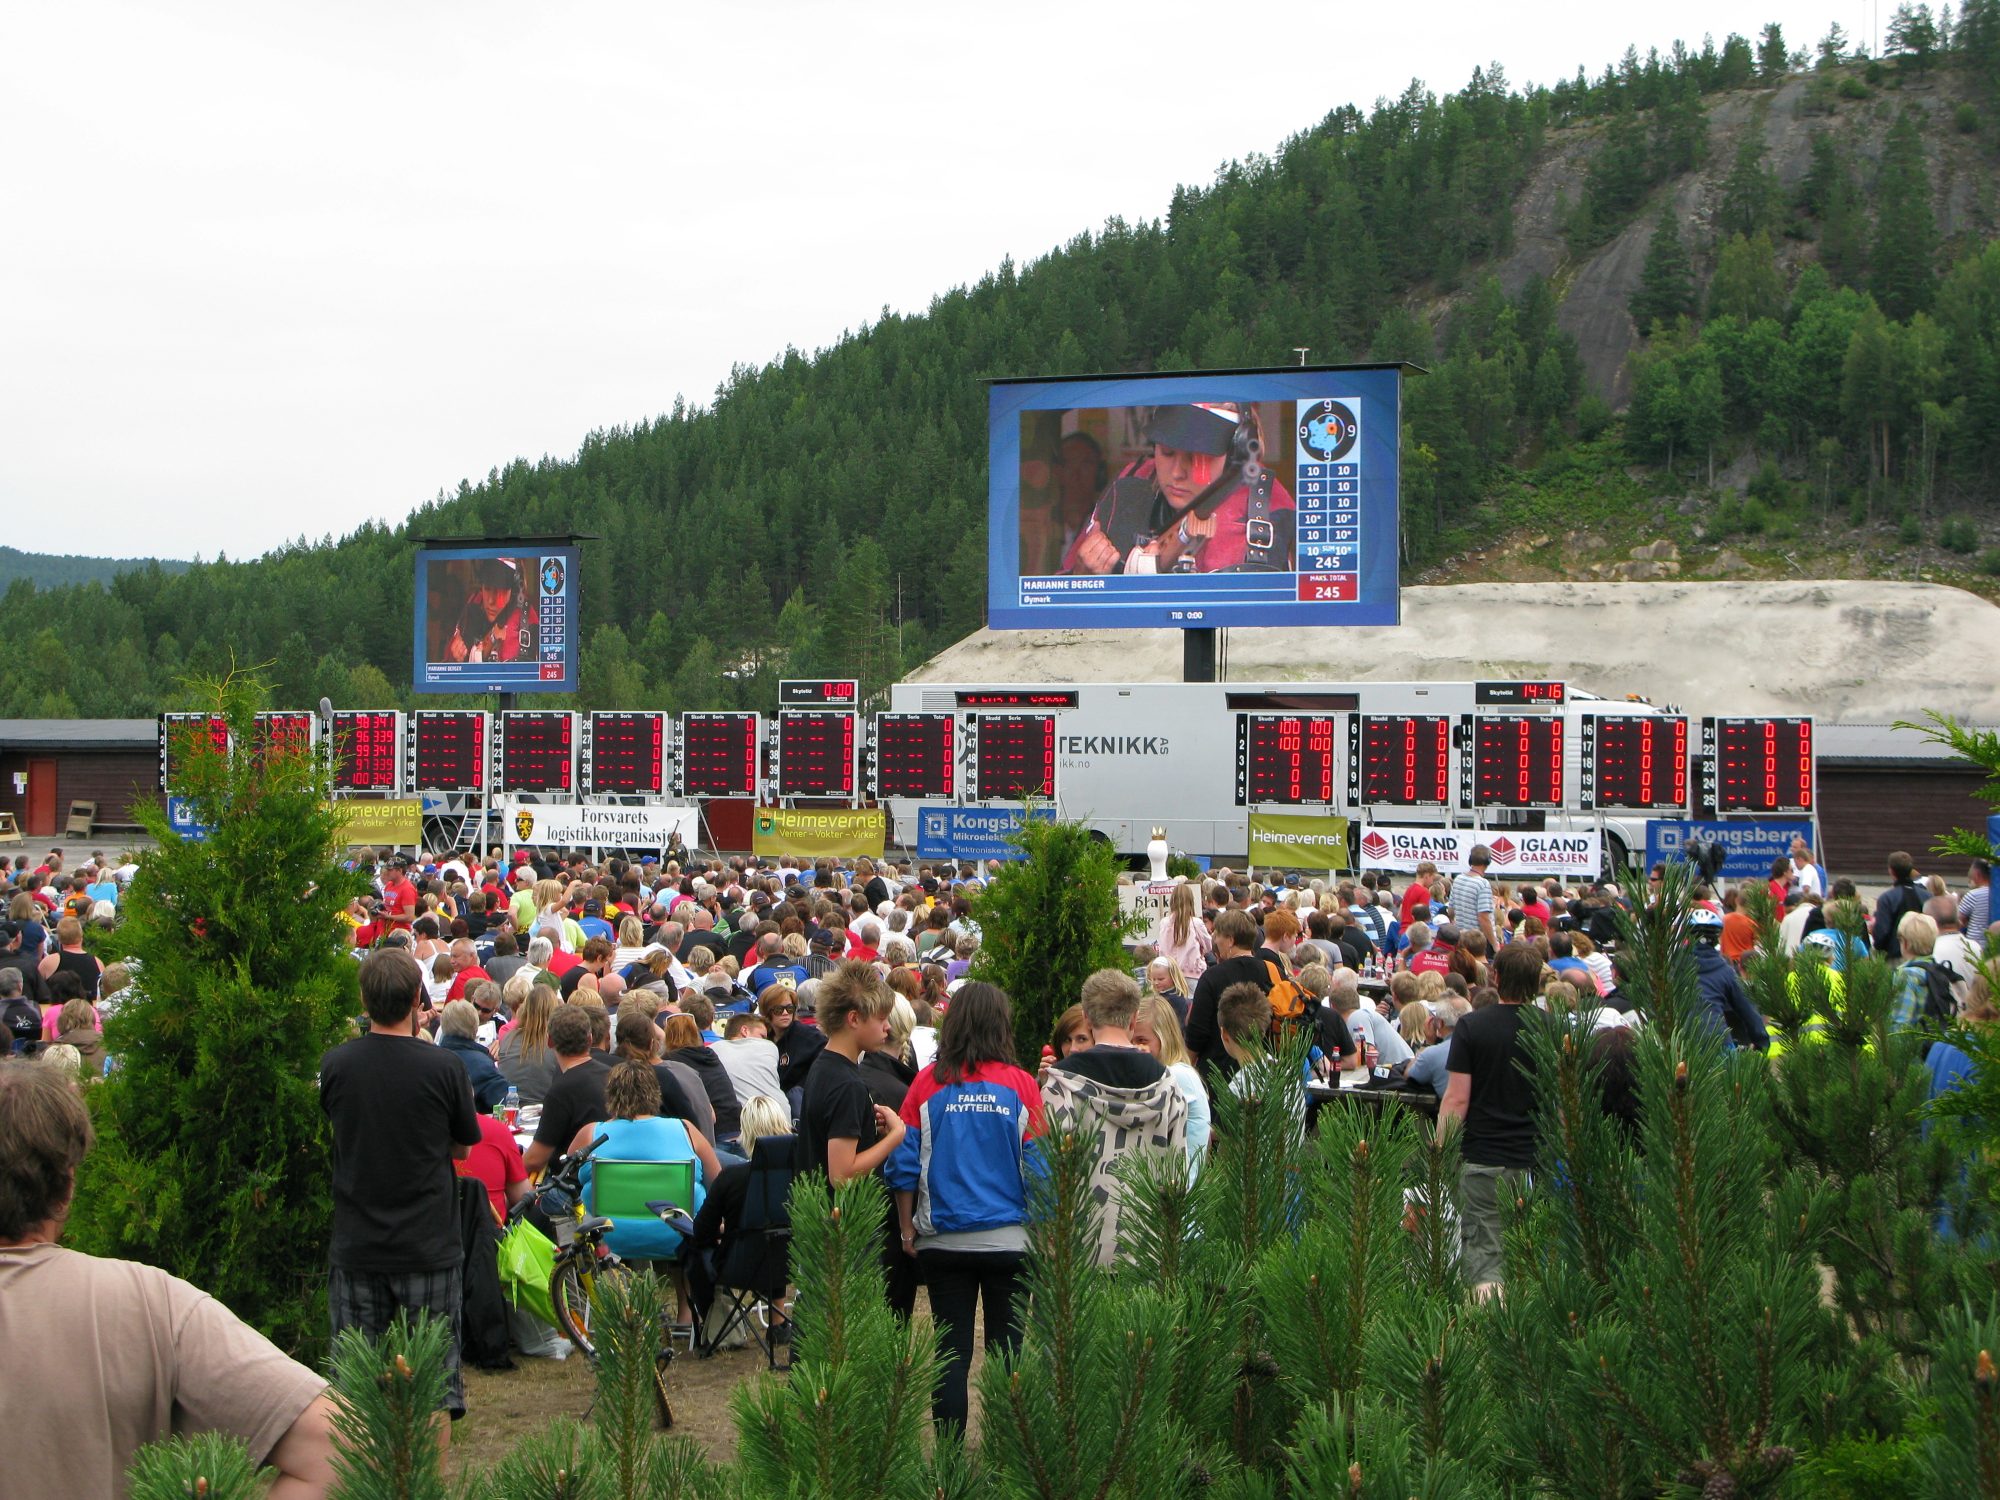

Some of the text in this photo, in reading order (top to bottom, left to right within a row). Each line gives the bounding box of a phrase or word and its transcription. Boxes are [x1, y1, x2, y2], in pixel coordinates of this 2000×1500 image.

[1323, 400, 1332, 412] 9
[1300, 425, 1356, 438] 9 9
[1323, 450, 1332, 462] 9
[1307, 465, 1350, 476] 10 10
[1307, 482, 1350, 492] 10 10
[1307, 498, 1350, 508] 10 10
[1307, 530, 1320, 540] 10
[1307, 546, 1320, 556] 10
[1315, 556, 1340, 569] 245
[1023, 580, 1105, 590] MARIANNE BERGER
[1315, 586, 1340, 599] 245
[1171, 611, 1183, 620] TID
[546, 652, 557, 661] 245
[546, 671, 557, 679] 245
[824, 683, 852, 697] 0:00
[1524, 684, 1561, 698] 14:16
[356, 716, 393, 728] 98 341
[408, 720, 415, 729] 16
[583, 720, 591, 730] 26
[675, 721, 684, 730] 31
[770, 720, 779, 730] 36
[867, 722, 876, 732] 41
[966, 723, 976, 733] 46
[1240, 724, 1244, 734] 1
[1279, 721, 1331, 735] 100 100
[1351, 723, 1357, 734] 6
[1462, 725, 1472, 735] 11
[1583, 725, 1593, 736] 16
[1703, 727, 1715, 739] 21
[356, 730, 393, 742] 96 339
[408, 734, 415, 742] 17
[583, 734, 591, 744] 27
[675, 736, 684, 746] 32
[770, 735, 779, 744] 37
[867, 737, 876, 746] 42
[966, 738, 976, 748] 47
[1059, 736, 1158, 754] TEKNIKK
[1239, 740, 1245, 750] 2
[1279, 736, 1331, 751] 100 100
[1351, 740, 1357, 750] 7
[1462, 741, 1472, 751] 12
[1583, 741, 1593, 752] 17
[356, 744, 393, 756] 99 341
[408, 748, 415, 757] 18
[582, 749, 591, 758] 28
[770, 750, 779, 760] 38
[1703, 744, 1715, 756] 22
[675, 751, 684, 760] 33
[867, 752, 876, 762] 43
[966, 753, 976, 763] 48
[1239, 755, 1245, 766] 3
[356, 758, 393, 770] 97 339
[1351, 756, 1357, 766] 8
[1462, 757, 1472, 768] 13
[1583, 757, 1593, 768] 18
[408, 762, 415, 771] 19
[582, 764, 591, 774] 29
[675, 765, 684, 776] 34
[770, 765, 779, 774] 39
[867, 767, 876, 776] 44
[1703, 761, 1715, 772] 23
[352, 772, 393, 785] 100 342
[966, 769, 976, 779] 49
[1238, 771, 1244, 782] 4
[1351, 772, 1357, 782] 9
[1462, 773, 1472, 784] 14
[407, 776, 414, 785] 20
[582, 778, 591, 788] 30
[675, 780, 684, 790] 35
[770, 779, 779, 789] 40
[1583, 774, 1593, 786] 19
[1703, 778, 1715, 790] 24
[867, 782, 876, 792] 45
[966, 784, 976, 794] 50
[1238, 787, 1244, 798] 5
[1349, 788, 1358, 798] 10
[1462, 790, 1472, 800] 15
[1581, 790, 1593, 802] 20
[1703, 794, 1715, 806] 25
[581, 808, 649, 824] Forsvarets
[773, 811, 885, 828] Heimevernet
[362, 819, 385, 827] Vokter
[394, 819, 416, 827] Virker
[952, 814, 1020, 833] Kongsb
[780, 829, 878, 839] Verner Vokter Virker
[1252, 829, 1342, 846] Heimevernet
[1689, 826, 1803, 846] Kongsberg
[1392, 834, 1458, 850] IGLAND
[1521, 838, 1588, 852] IGLAND
[952, 846, 1001, 854] Elektroniske
[1393, 848, 1459, 861] GARASJEN
[1520, 852, 1589, 863] GARASJEN
[1135, 895, 1169, 908] Blak
[958, 1094, 996, 1103] FALKEN
[945, 1103, 1010, 1116] SKYTTERLAG
